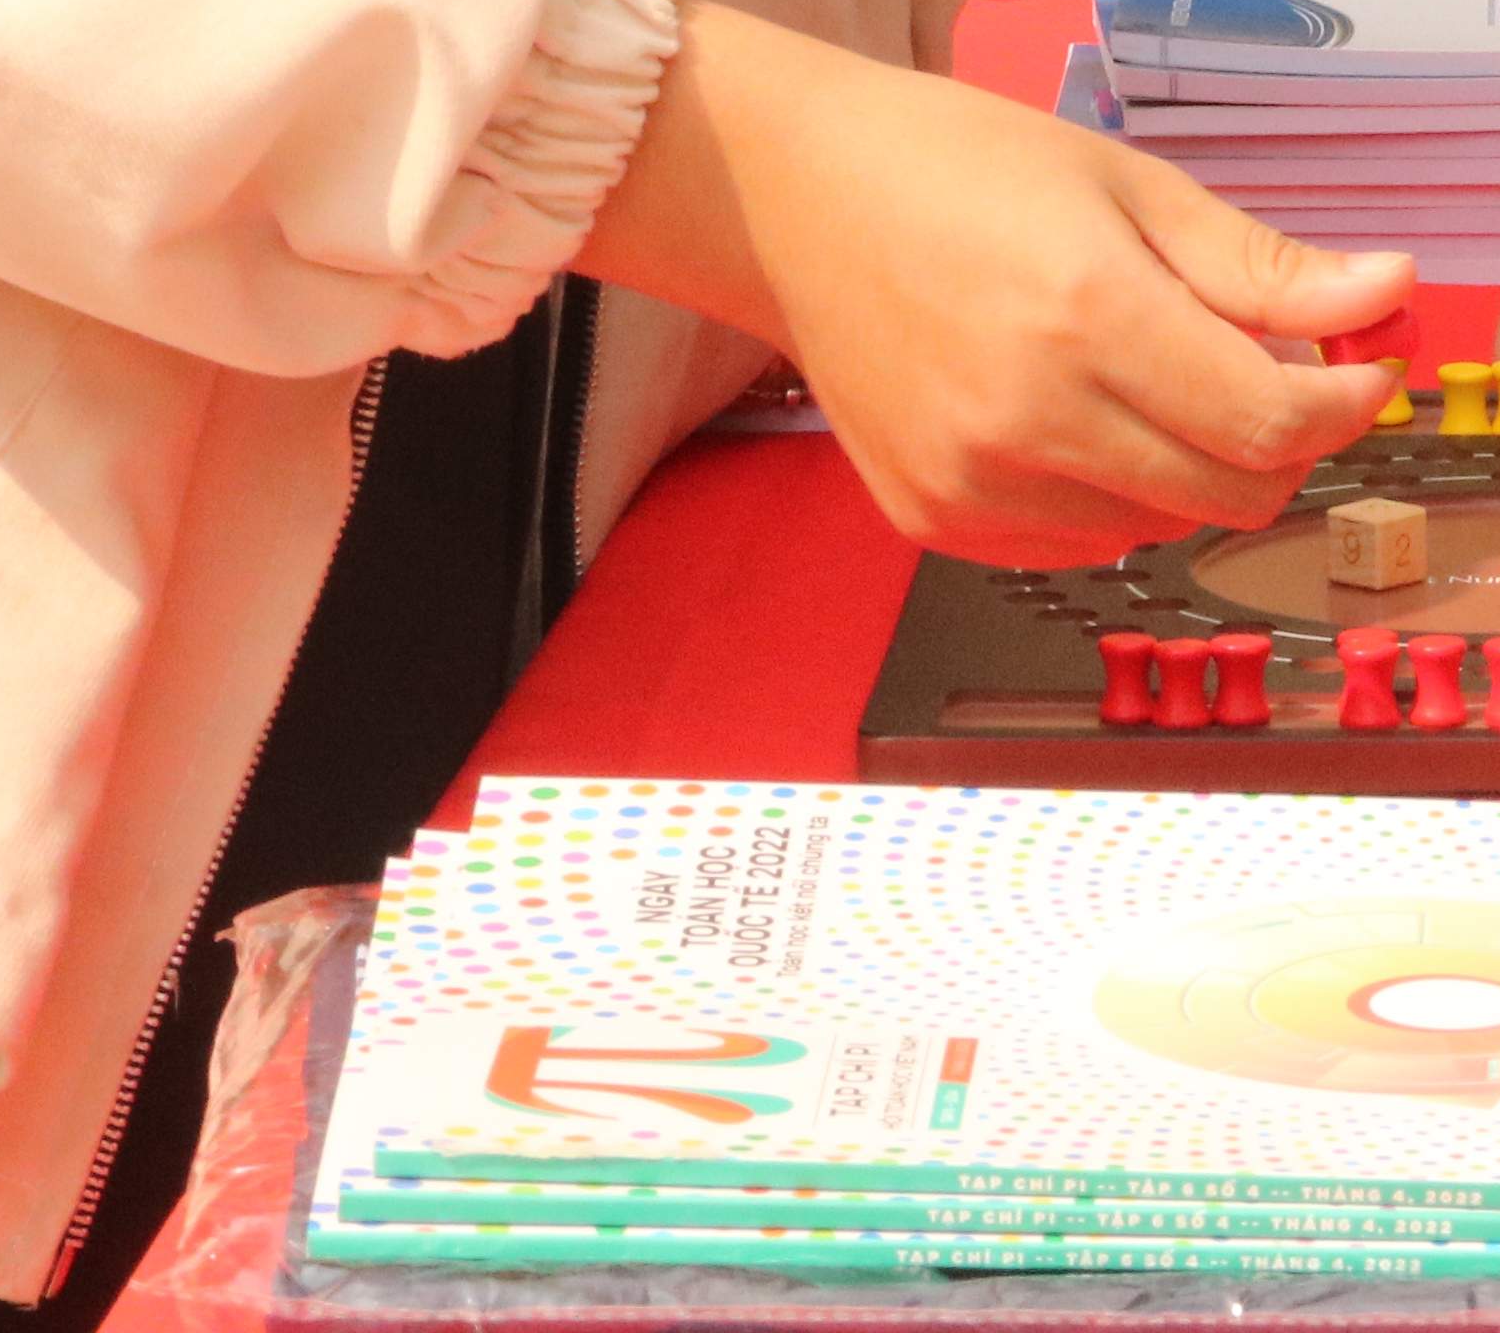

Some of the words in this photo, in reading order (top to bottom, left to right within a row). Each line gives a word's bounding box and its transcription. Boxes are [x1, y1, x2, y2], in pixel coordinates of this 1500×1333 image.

[1395, 532, 1411, 567] 2
[806, 815, 830, 830] ta
[692, 845, 741, 890] HỌC
[746, 826, 792, 880] 2022
[797, 833, 832, 876] chúng
[631, 869, 681, 924] NGÀY
[733, 885, 780, 909] TẾ
[676, 896, 727, 949] TOÁN
[723, 914, 775, 968] QUỐC
[844, 1042, 882, 1056] PI
[1013, 1174, 1054, 1192] CHÍ
[1064, 1179, 1087, 1193] PI
[1182, 1182, 1195, 1196] 6
[1247, 1184, 1260, 1198] 4
[1301, 1185, 1381, 1202] THÁNG
[1425, 1190, 1483, 1205] 2022
[982, 1208, 1023, 1224] CHÍ
[1033, 1210, 1057, 1226] PI
[1152, 1214, 1165, 1228] 6
[1216, 1215, 1230, 1230] 4
[1270, 1215, 1351, 1232] THÁNG
[1395, 1220, 1452, 1234] 2022
[951, 1247, 990, 1265] CHÍ
[1002, 1251, 1026, 1265] PI
[1120, 1253, 1133, 1267] 6
[1185, 1255, 1199, 1268] 4
[1240, 1253, 1322, 1271] THÁNG
[1364, 1258, 1422, 1274] 2022
